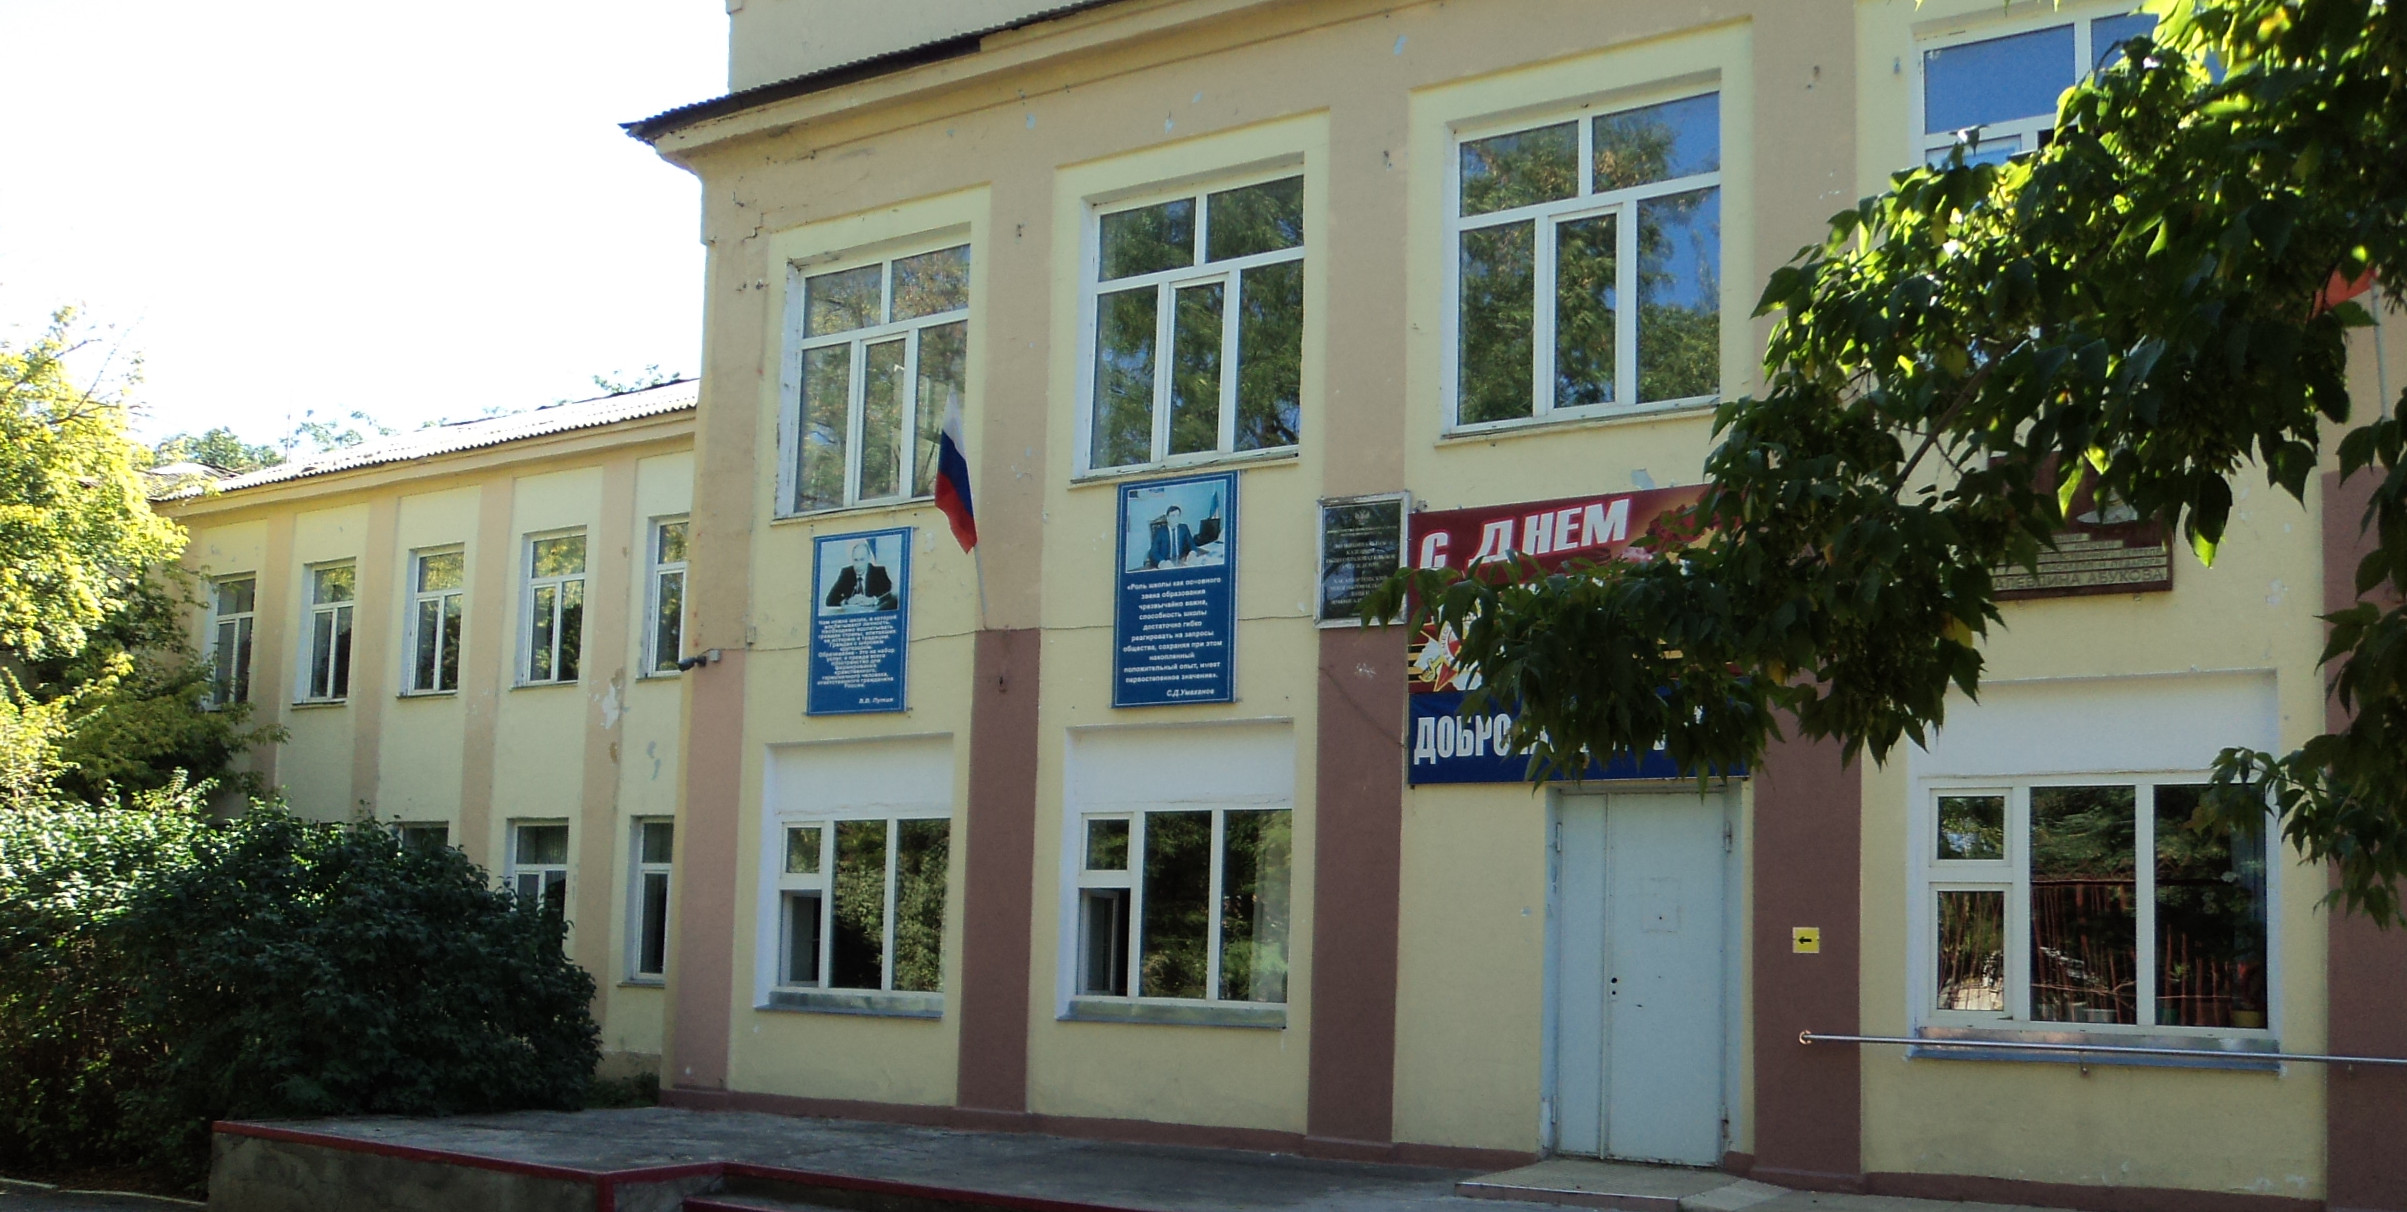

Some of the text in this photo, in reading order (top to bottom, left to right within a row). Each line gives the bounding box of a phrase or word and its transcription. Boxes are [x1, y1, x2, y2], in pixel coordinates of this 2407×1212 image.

[1420, 498, 1630, 569] С ДНЕМ
[1185, 577, 1221, 586] основного
[2088, 570, 2163, 585] АБУКОВА
[1162, 589, 1206, 598] образования
[1139, 601, 1183, 610] чрезвычайно
[1139, 612, 1182, 620] способность
[1142, 620, 1202, 631] достаточно гибко
[1131, 633, 1173, 642] реагировать
[1184, 630, 1214, 638] запросы
[1158, 642, 1190, 650] сохраняя
[1149, 652, 1195, 661] накопленный
[1124, 663, 1178, 673] положительный
[1125, 674, 1179, 683] первостепенное
[1413, 713, 1511, 765] ДОБРО
